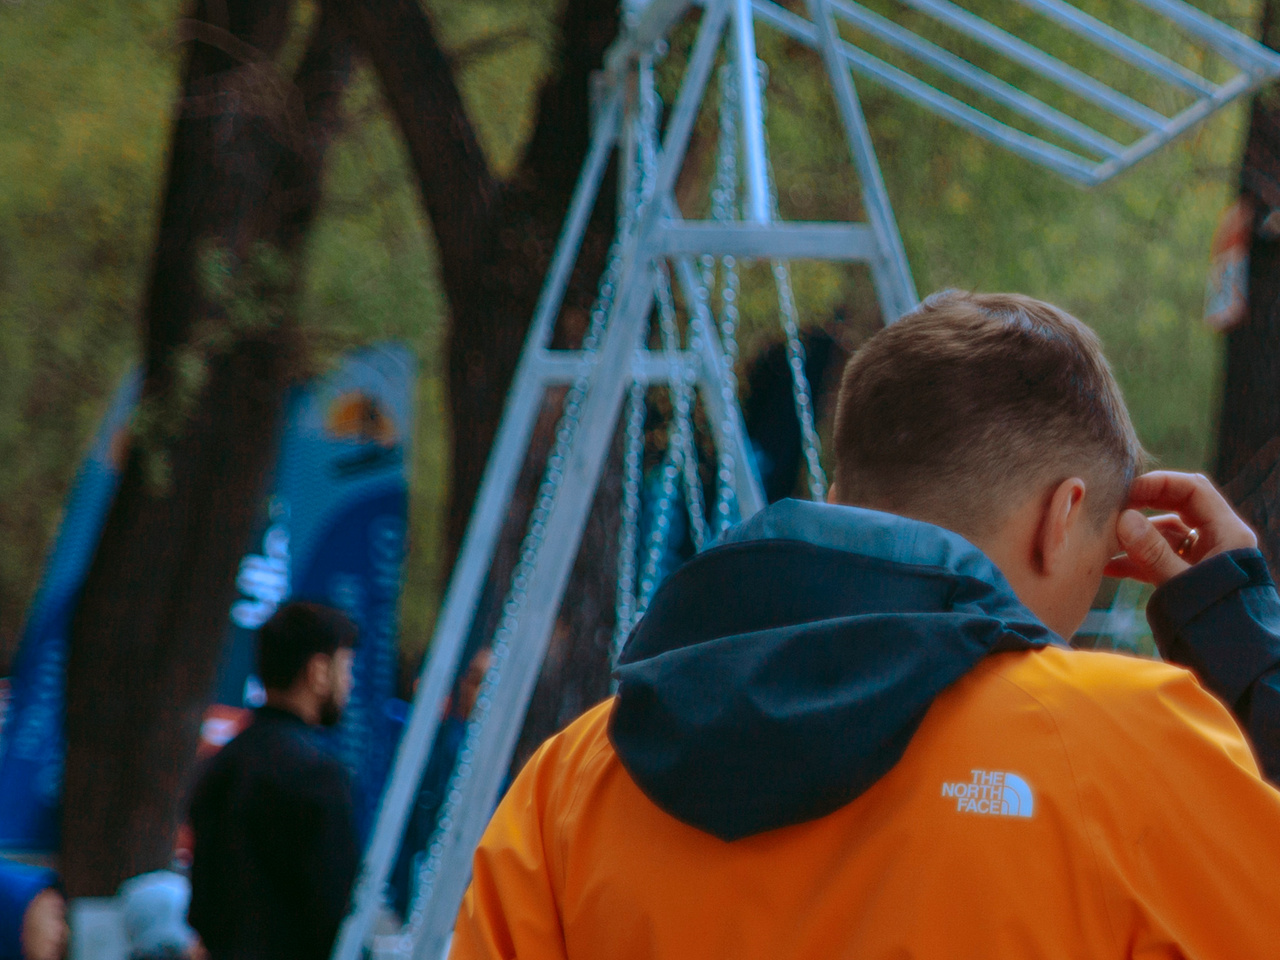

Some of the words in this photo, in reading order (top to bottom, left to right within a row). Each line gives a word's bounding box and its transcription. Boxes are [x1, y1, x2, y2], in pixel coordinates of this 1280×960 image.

[971, 770, 1004, 786] THE
[942, 782, 1002, 800] NORTH
[957, 797, 1001, 815] FACE
